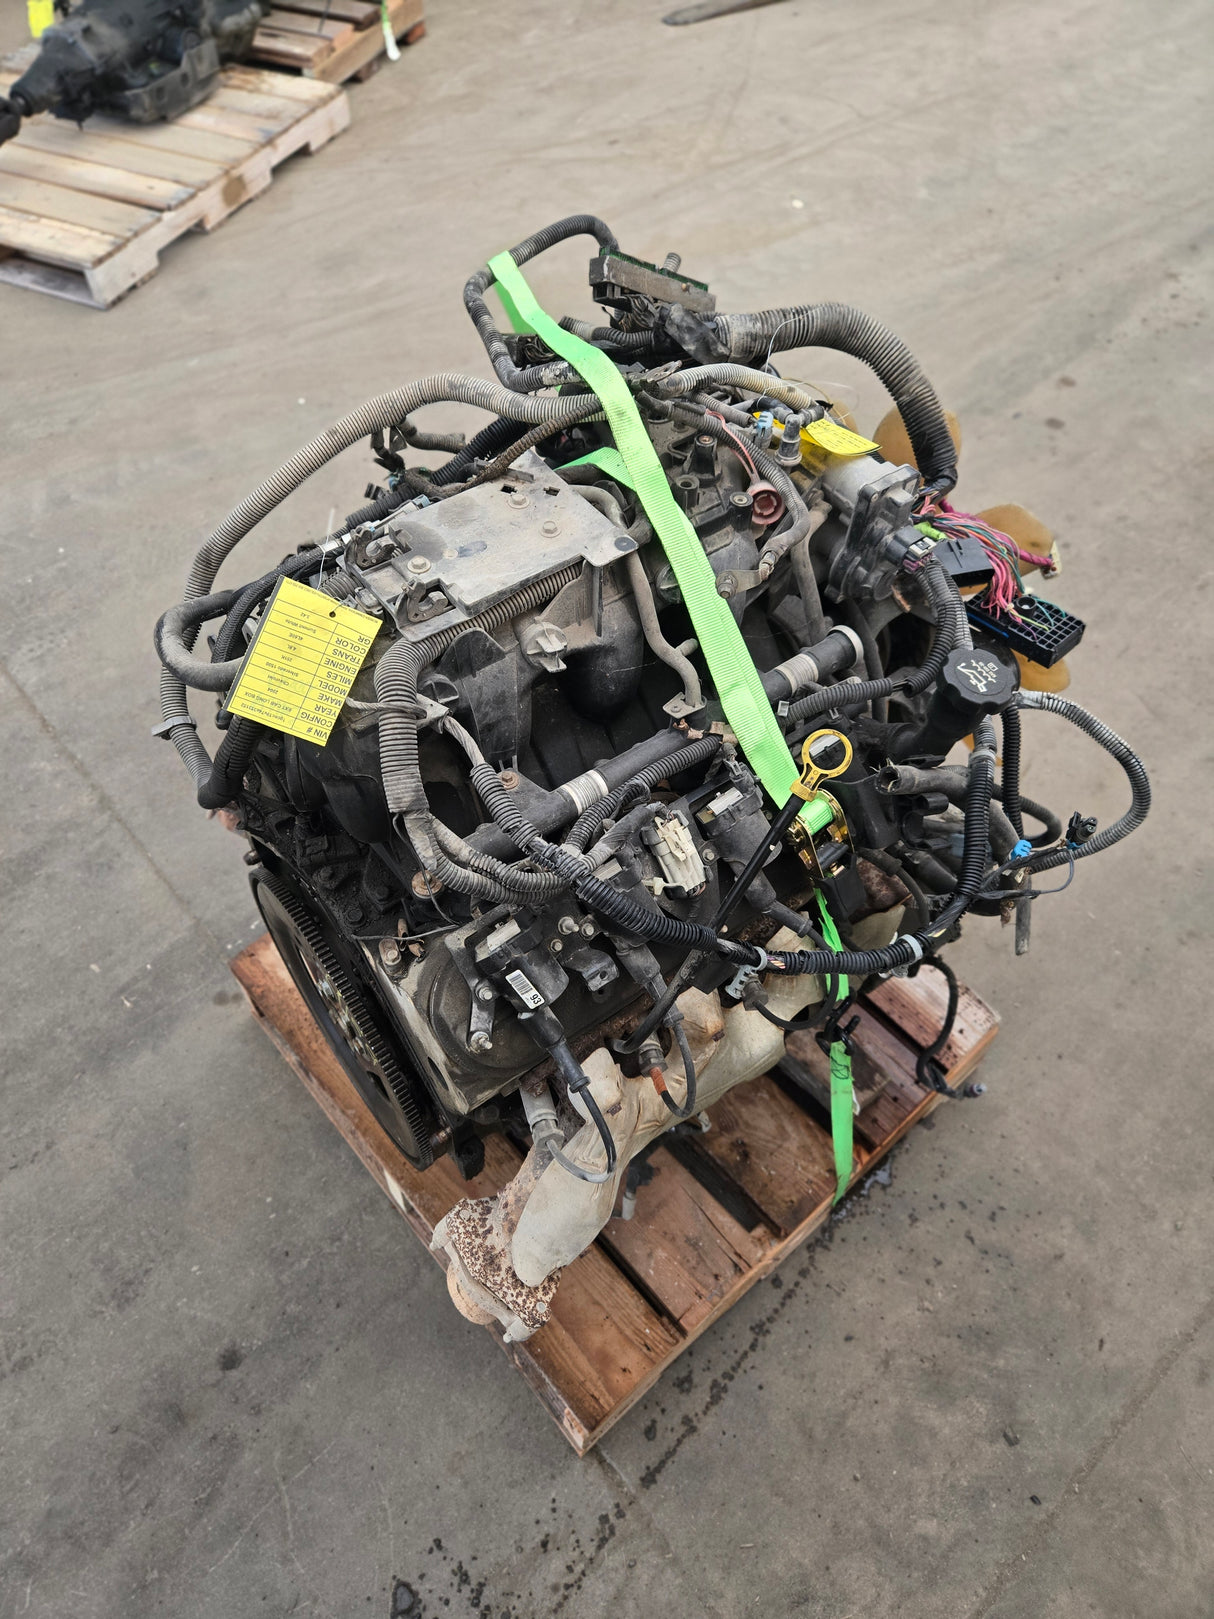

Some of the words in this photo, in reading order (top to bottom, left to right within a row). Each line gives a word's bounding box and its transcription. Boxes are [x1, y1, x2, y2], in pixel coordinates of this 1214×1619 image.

[334, 636, 367, 655] COLOR
[356, 634, 371, 646] GR
[330, 646, 362, 665] TRANS
[322, 656, 357, 676] ENGINE
[325, 669, 353, 686] MILES
[316, 678, 348, 697] MODEL
[316, 691, 343, 707] MAKE
[313, 702, 338, 718] YEAR
[299, 710, 333, 728] CONFIG
[305, 725, 313, 734] #
[313, 728, 329, 739] VIN
[530, 993, 542, 1005] 93
